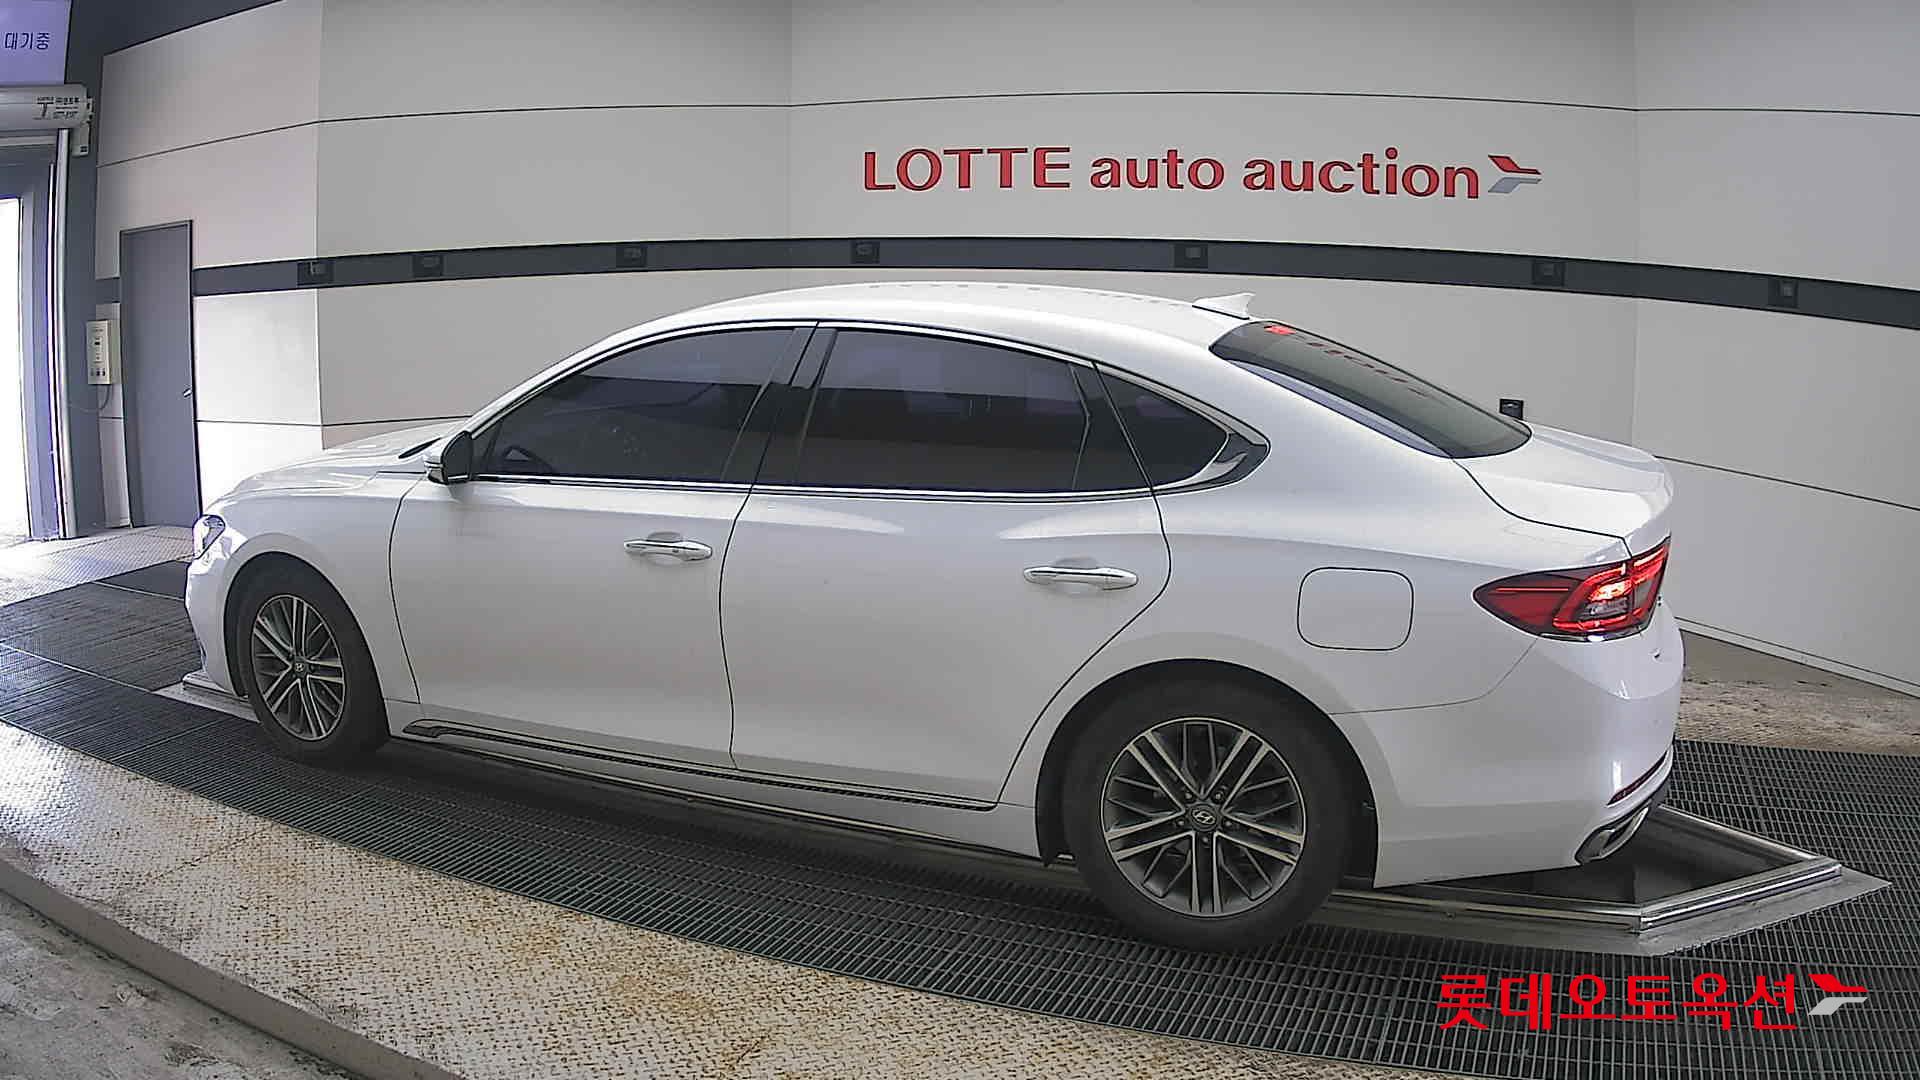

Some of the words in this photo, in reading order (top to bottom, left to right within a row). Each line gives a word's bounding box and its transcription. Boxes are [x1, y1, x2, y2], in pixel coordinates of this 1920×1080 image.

[4, 32, 50, 50] 대기중
[863, 146, 1071, 192] LOTTE
[1090, 148, 1225, 191] auto
[1243, 147, 1480, 199] auction
